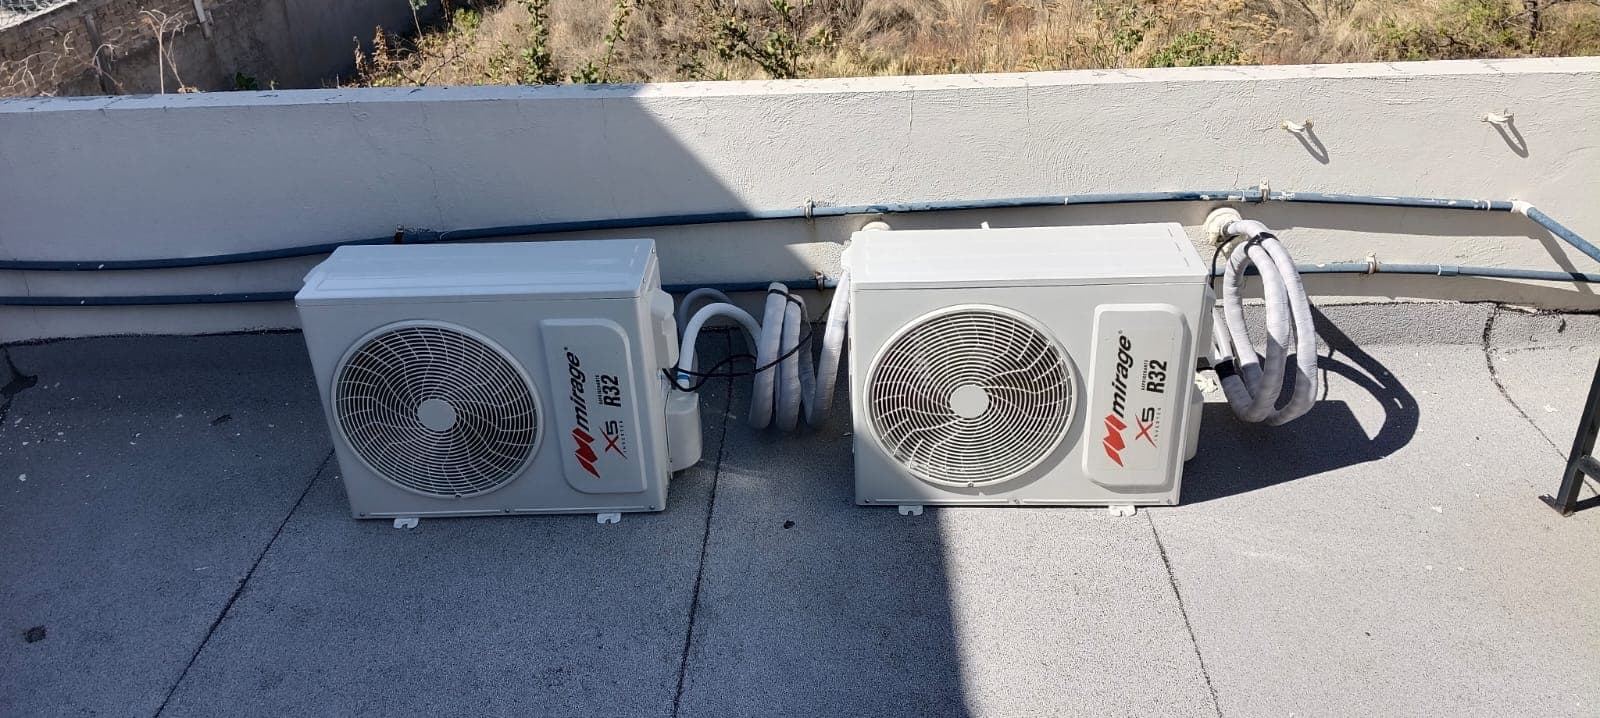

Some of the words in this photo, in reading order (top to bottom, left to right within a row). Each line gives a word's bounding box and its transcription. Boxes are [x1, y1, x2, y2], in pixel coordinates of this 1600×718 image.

[601, 375, 622, 408] R32
[1146, 359, 1168, 394] R32
[600, 420, 628, 460] X5
[1135, 407, 1157, 448] X5
